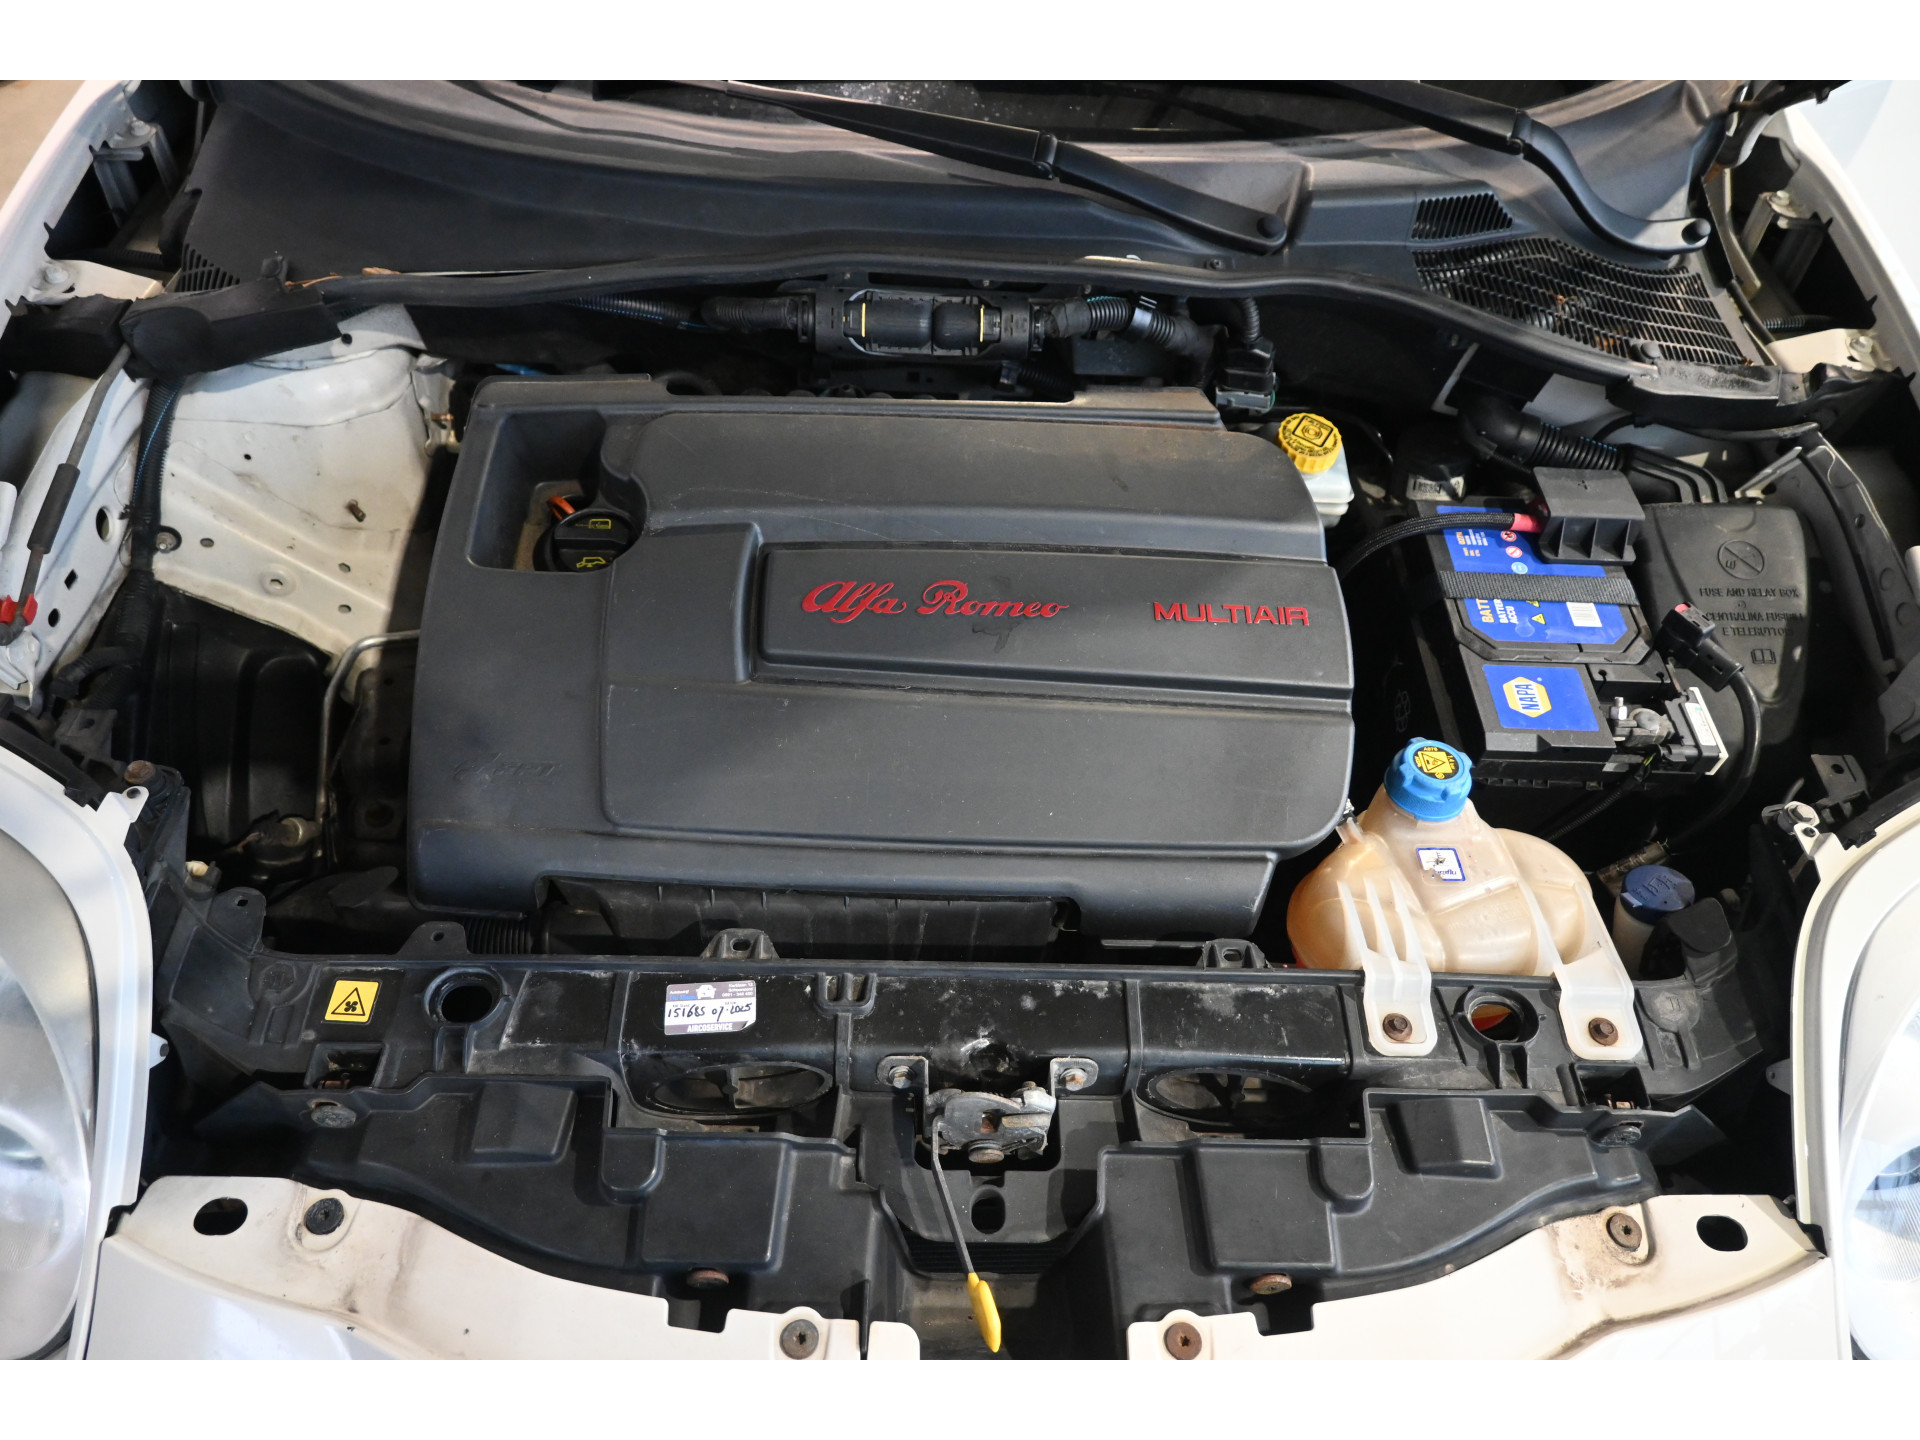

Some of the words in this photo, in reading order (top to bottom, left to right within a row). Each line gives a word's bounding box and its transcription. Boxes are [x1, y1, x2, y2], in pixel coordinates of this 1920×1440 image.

[801, 581, 906, 623] Alfa
[917, 580, 1070, 618] Romeo
[1699, 587, 1722, 598] FUSE
[1726, 587, 1745, 598] AND
[1748, 587, 1776, 598] RELAY
[1779, 587, 1800, 598] BOX
[1154, 602, 1310, 626] MULTIAIR
[1504, 605, 1519, 624] ACCU
[1514, 683, 1541, 711] NAPA
[687, 1022, 733, 1033] AIRCOSERVICE
